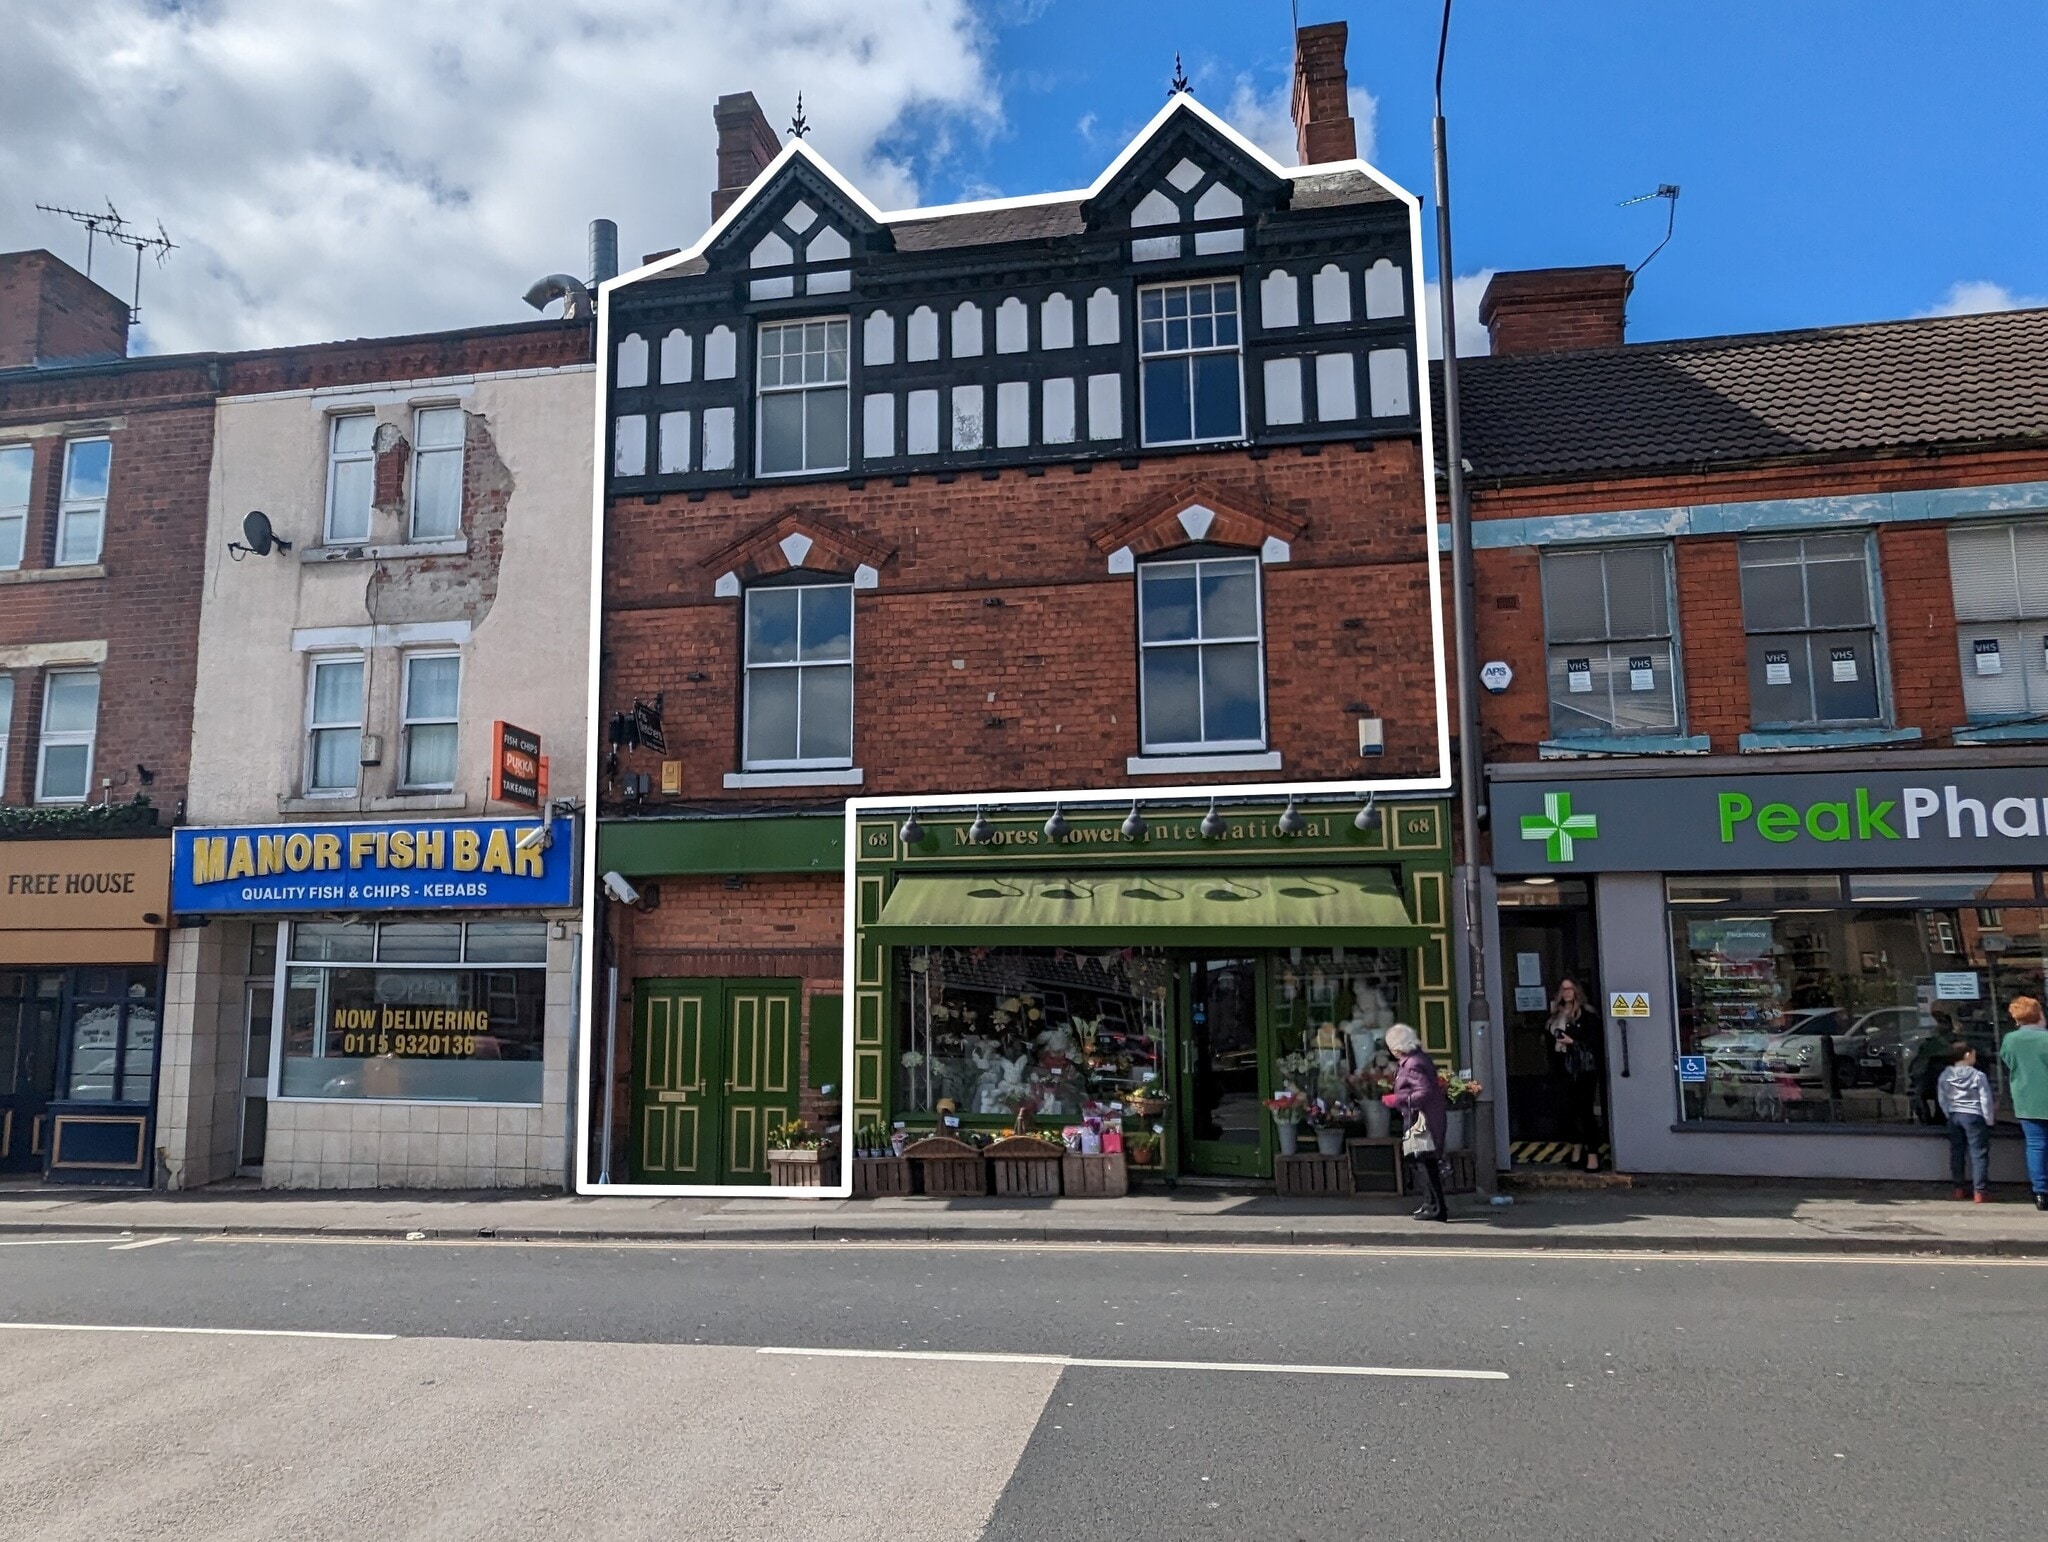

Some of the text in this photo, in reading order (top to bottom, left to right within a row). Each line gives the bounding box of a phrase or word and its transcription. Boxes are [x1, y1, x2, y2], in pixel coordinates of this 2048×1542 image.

[1832, 650, 1853, 660] VHS
[1975, 642, 1997, 652] VHS
[1569, 662, 1588, 671] VHS
[1631, 660, 1651, 669] VHS
[1766, 653, 1787, 663] VHS
[1485, 667, 1507, 676] APS
[504, 734, 538, 754] FISH CHIPS
[507, 753, 534, 773] PUKKA
[503, 780, 537, 797] TAKEAWAY
[1718, 785, 2048, 842] PeakPha
[1408, 817, 1430, 834] 68
[868, 832, 888, 847] 68
[955, 826, 1040, 846] Mores
[193, 828, 545, 885] MANOR FISH BAR
[8, 872, 136, 895] FREE HOUSE
[242, 886, 306, 901] QUALITY
[309, 886, 344, 899] FISH
[348, 885, 359, 899] &
[362, 884, 411, 898] CHIPS
[423, 883, 488, 897] KEBABS
[334, 1009, 489, 1031] NOW DELIVERING
[344, 1034, 476, 1055] 0115 9320136
